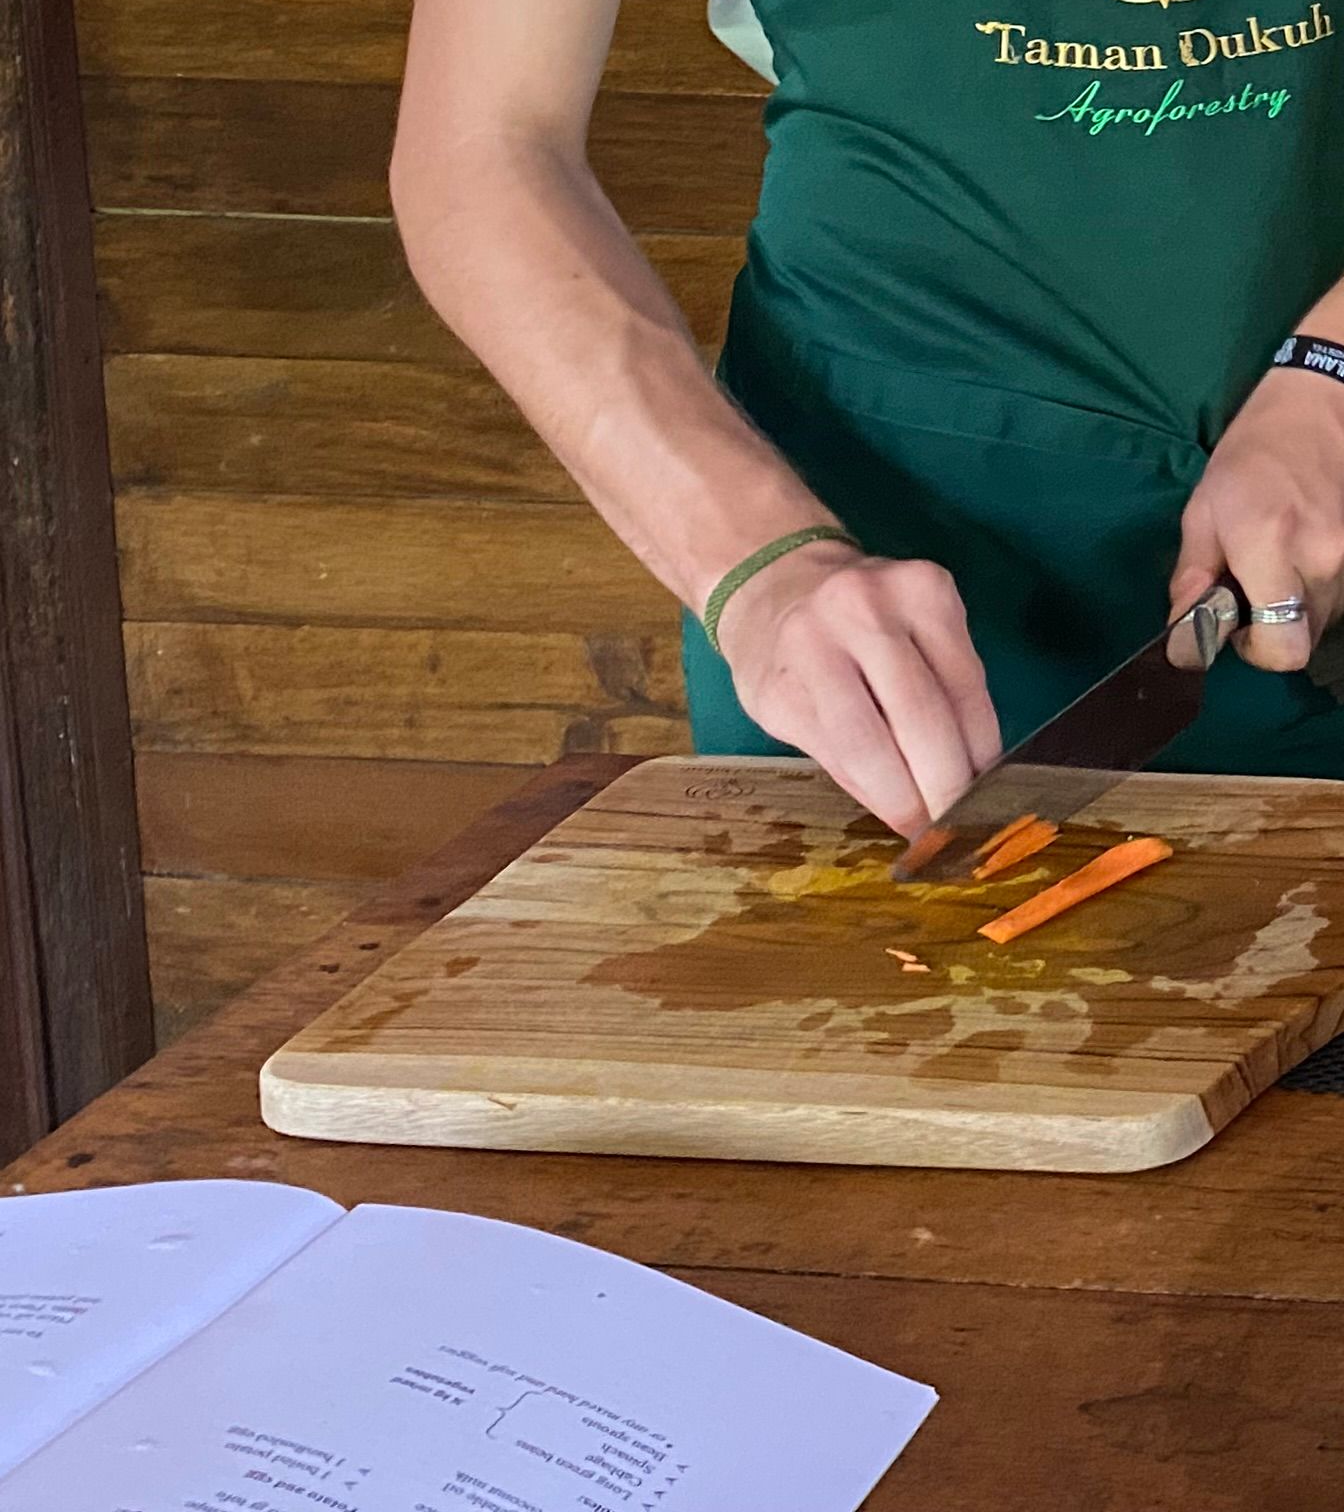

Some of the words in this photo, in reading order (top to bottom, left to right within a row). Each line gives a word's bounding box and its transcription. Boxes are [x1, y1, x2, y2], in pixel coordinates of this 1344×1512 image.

[975, 19, 1167, 71] Taman
[1179, 2, 1335, 68] Dukuh
[1034, 78, 1291, 136] Agroforestry
[515, 1440, 554, 1464] beans
[600, 1442, 655, 1474] Spinach
[632, 1440, 667, 1462] Bean
[584, 1454, 643, 1488] Cabbage
[595, 1475, 633, 1501] Long
